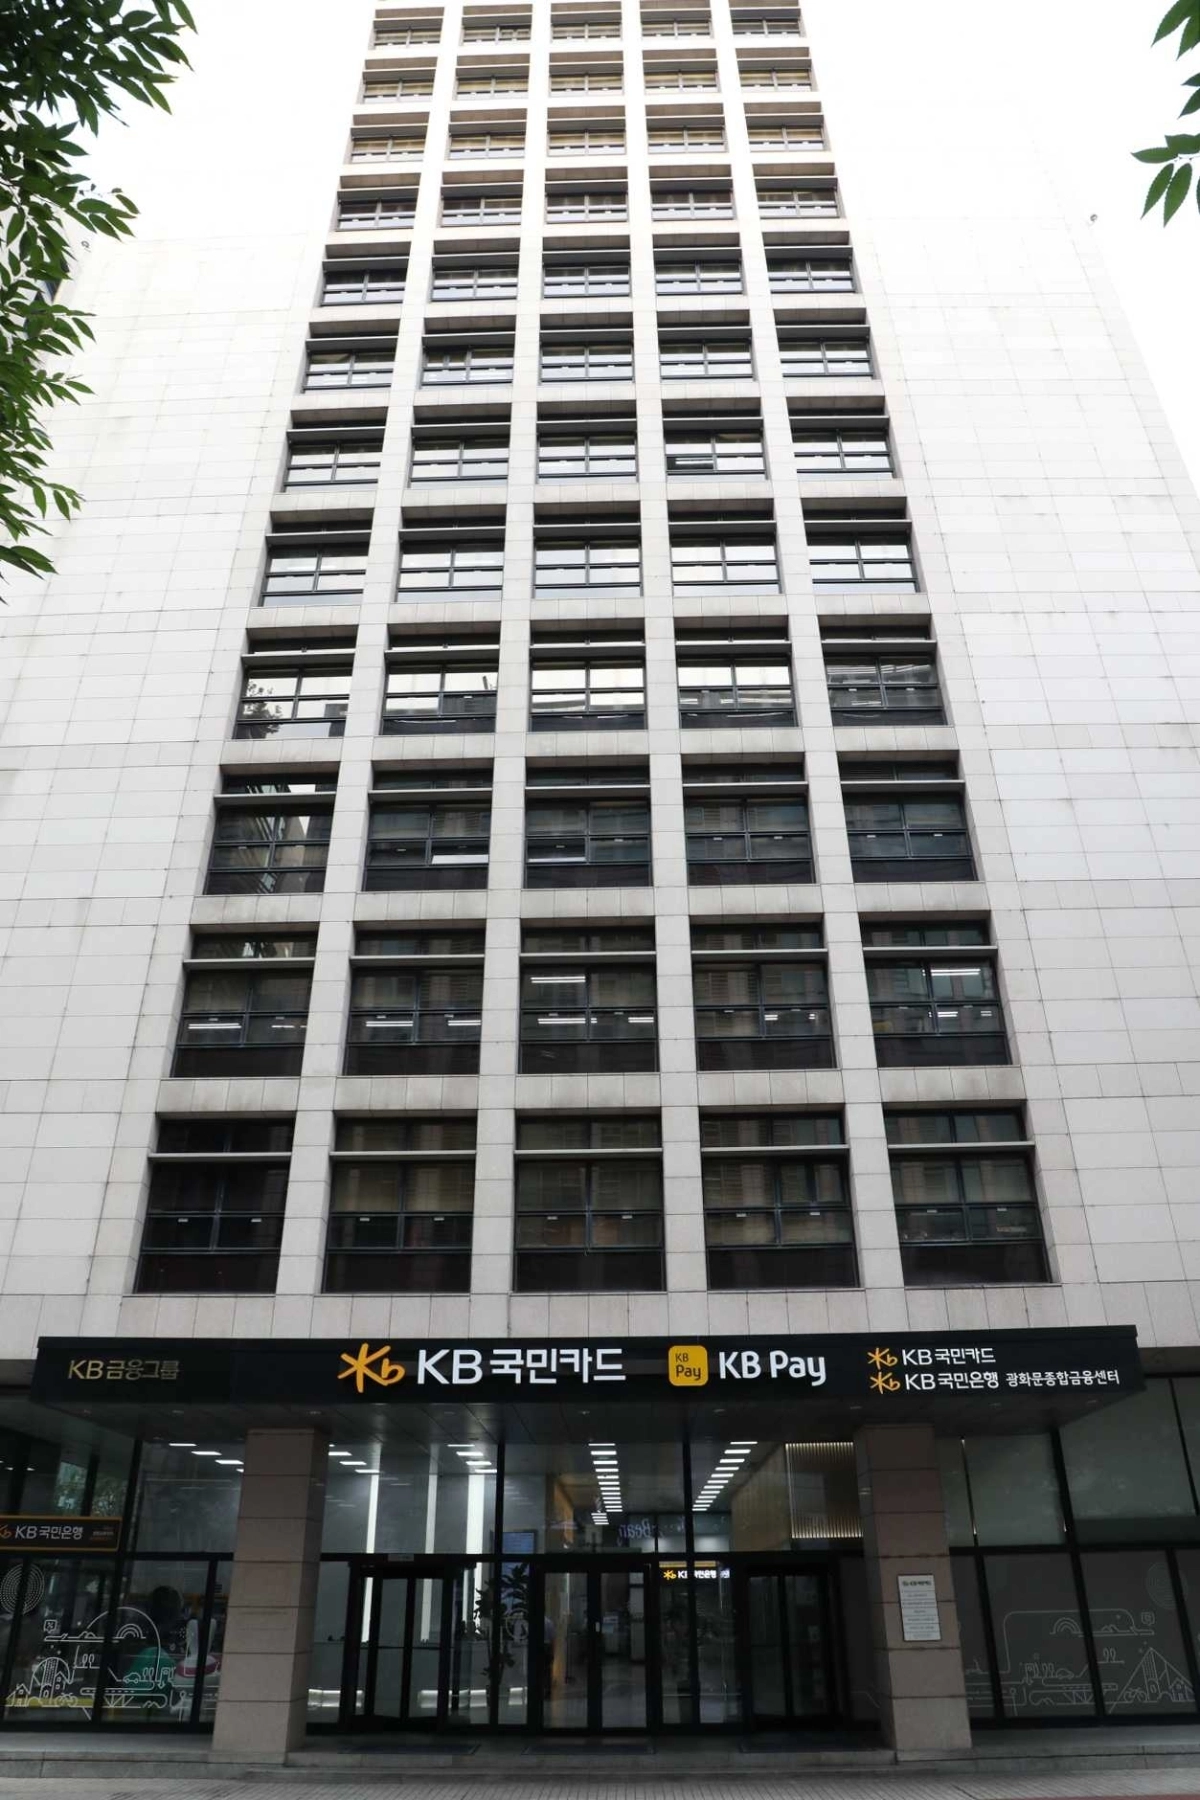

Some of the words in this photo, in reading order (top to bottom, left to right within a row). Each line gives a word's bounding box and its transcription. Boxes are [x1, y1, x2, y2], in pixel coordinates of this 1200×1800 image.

[417, 1348, 626, 1384] KB국민카드
[675, 1353, 689, 1363] KB
[902, 1347, 996, 1366] KB국민카드
[68, 1359, 179, 1380] KB금융그룹
[676, 1364, 701, 1380] Pay
[719, 1351, 762, 1379] KB
[769, 1350, 827, 1386] Pay
[904, 1371, 999, 1391] KB국민은행
[1005, 1369, 1120, 1388] 광화문종합금융센터
[14, 1525, 84, 1540] KB국민은행
